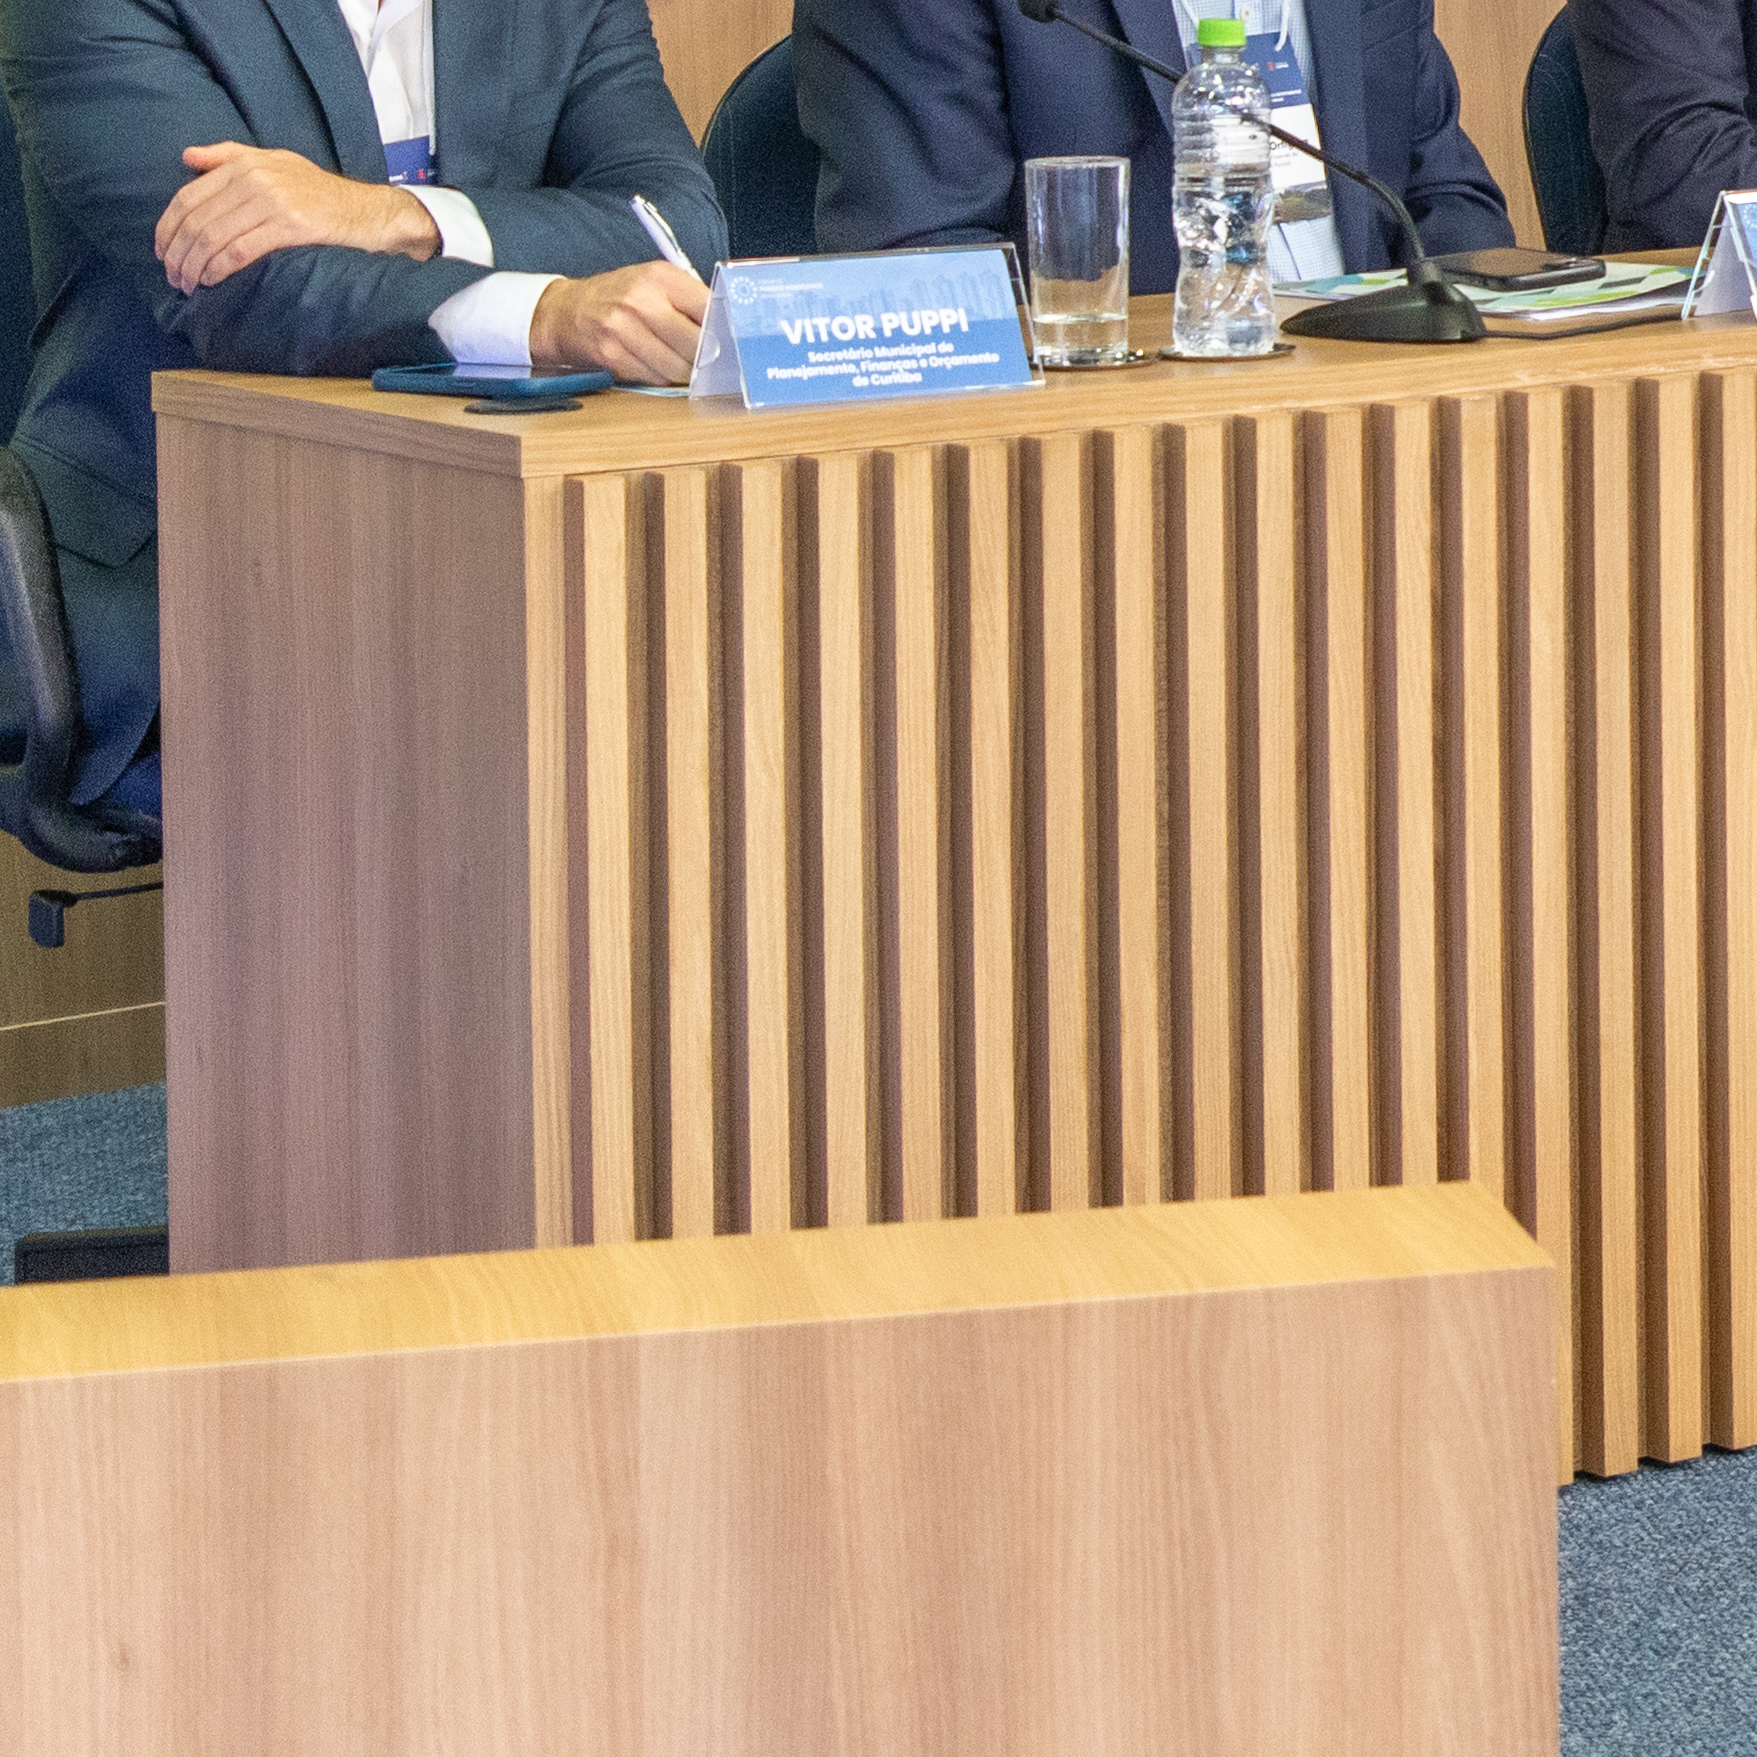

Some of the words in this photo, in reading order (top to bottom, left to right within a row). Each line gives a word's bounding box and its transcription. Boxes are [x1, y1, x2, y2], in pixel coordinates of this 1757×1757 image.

[780, 314, 877, 345] VITOR
[880, 308, 969, 338] PUPPI
[808, 347, 874, 363] Secretário
[874, 343, 937, 359] Municipal
[937, 342, 954, 354] de
[860, 358, 918, 373] Finanças
[919, 359, 928, 368] e
[928, 352, 1000, 370] Orçamento
[852, 375, 869, 387] de
[870, 371, 922, 385] Curitiba
